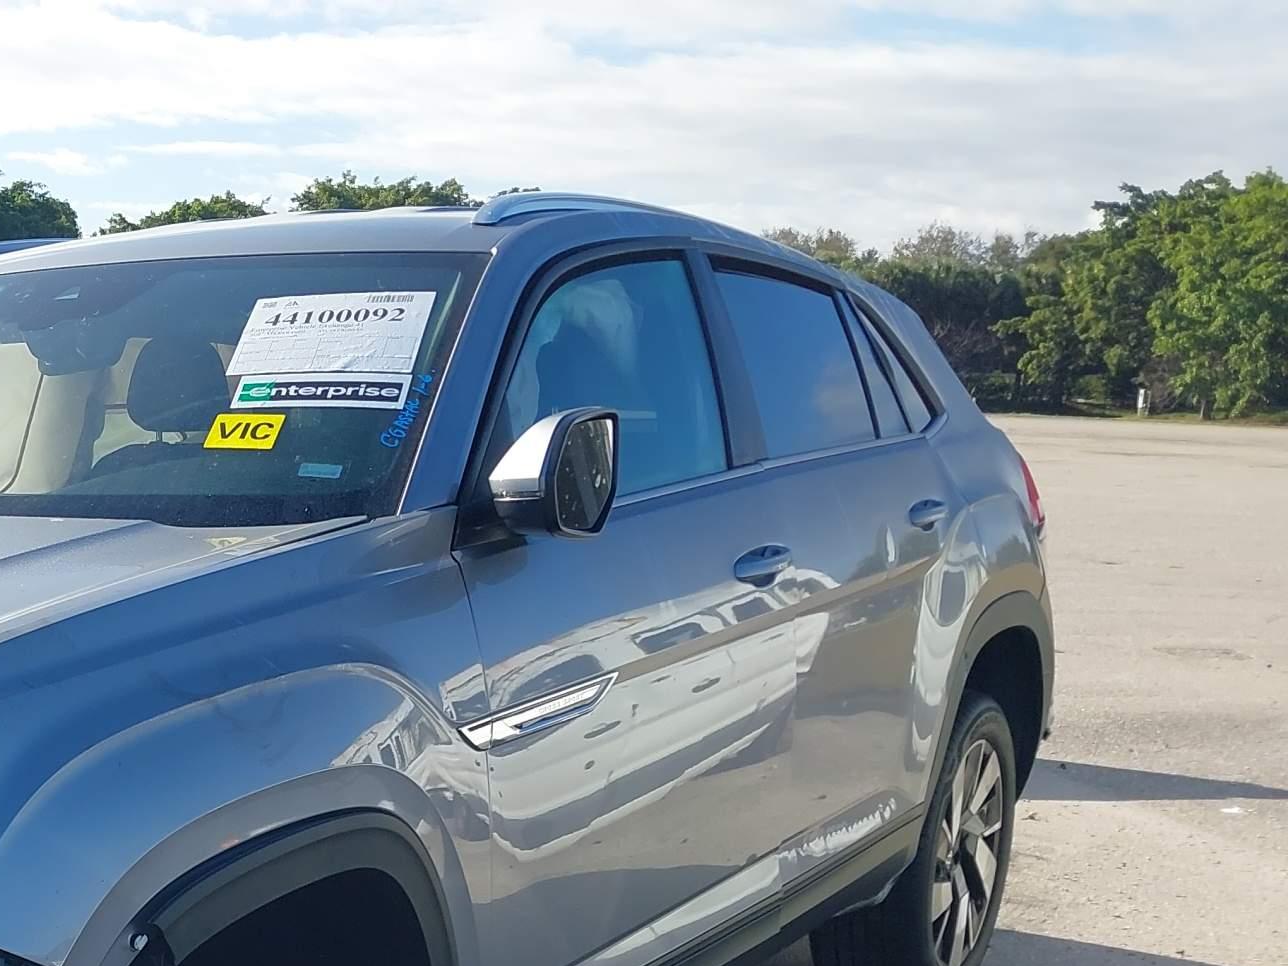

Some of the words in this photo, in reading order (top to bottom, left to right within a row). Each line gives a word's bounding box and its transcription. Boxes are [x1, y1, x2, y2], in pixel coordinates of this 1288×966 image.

[264, 307, 407, 326] 44100092
[249, 383, 401, 399] enterprise
[218, 421, 275, 440] VIC
